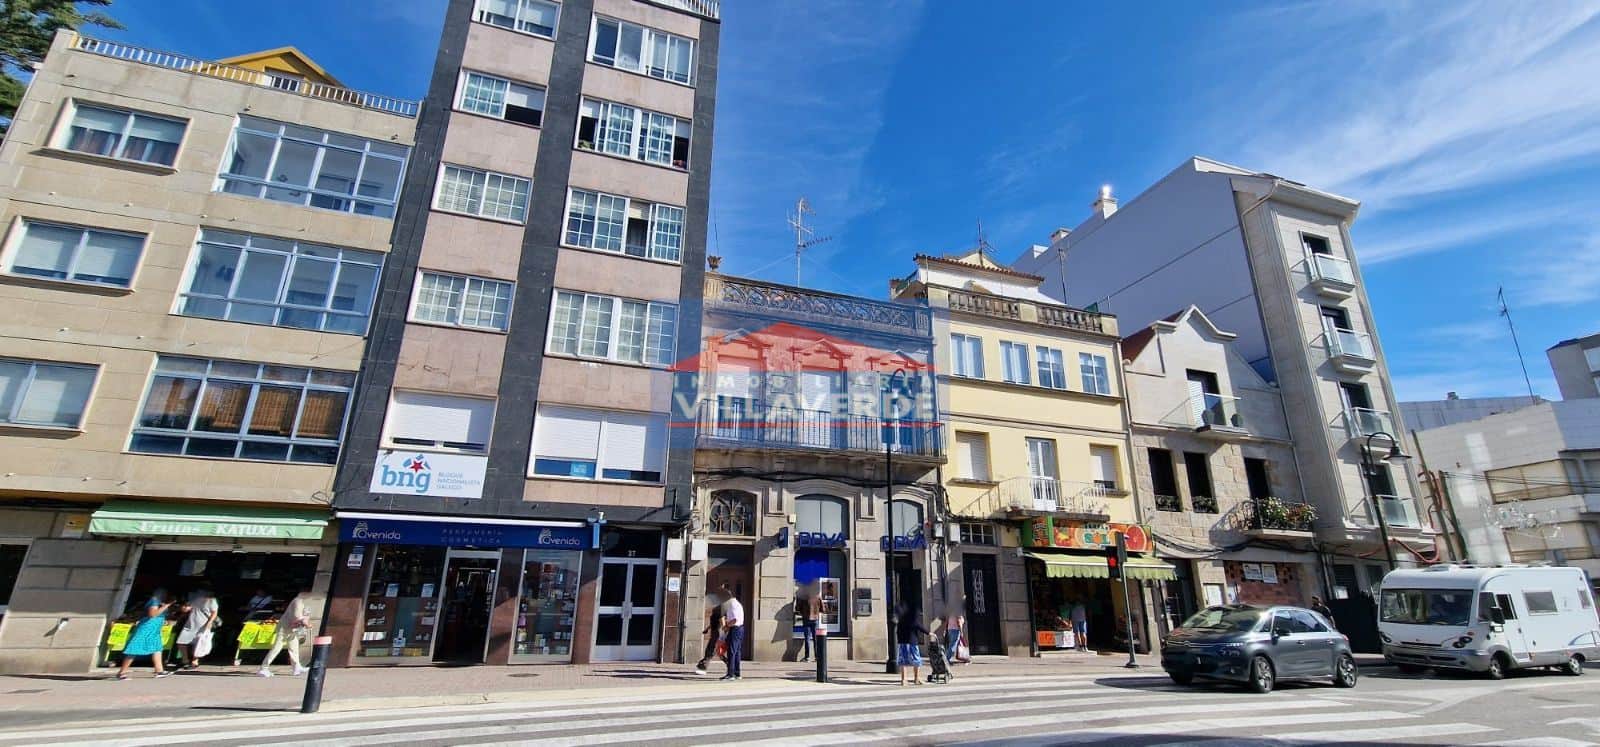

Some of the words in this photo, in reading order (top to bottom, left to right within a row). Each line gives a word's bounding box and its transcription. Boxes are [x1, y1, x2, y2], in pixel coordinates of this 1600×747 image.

[380, 464, 431, 493] bng
[141, 521, 201, 534] Frutas
[215, 523, 279, 537] KATUXA
[799, 531, 847, 547] BBVA
[882, 535, 927, 548] BBVA
